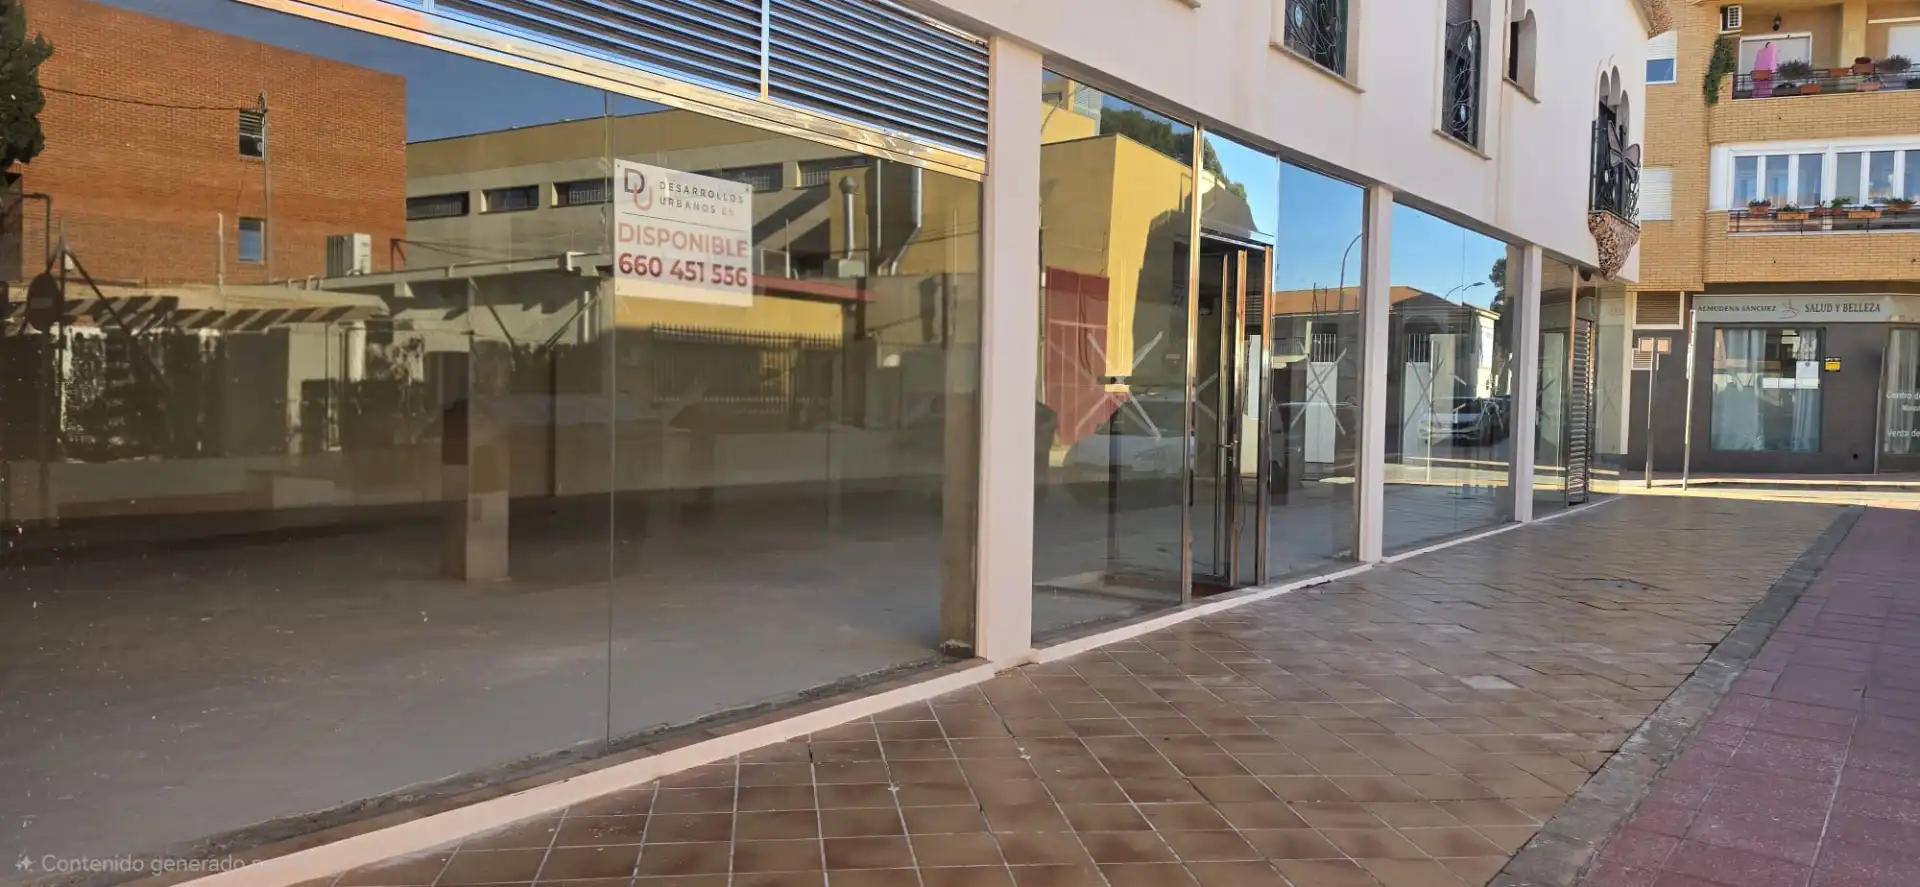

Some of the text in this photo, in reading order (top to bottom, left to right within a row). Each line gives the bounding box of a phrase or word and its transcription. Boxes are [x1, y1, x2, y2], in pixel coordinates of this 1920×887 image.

[659, 181, 744, 204] DESARROLLOS
[659, 196, 716, 214] URBANOS
[618, 222, 749, 259] DISPONIBLE
[618, 252, 748, 287] 660 451 556
[1804, 303, 1881, 313] SALUD Y BELLEZA
[1886, 392, 1912, 400] Centro
